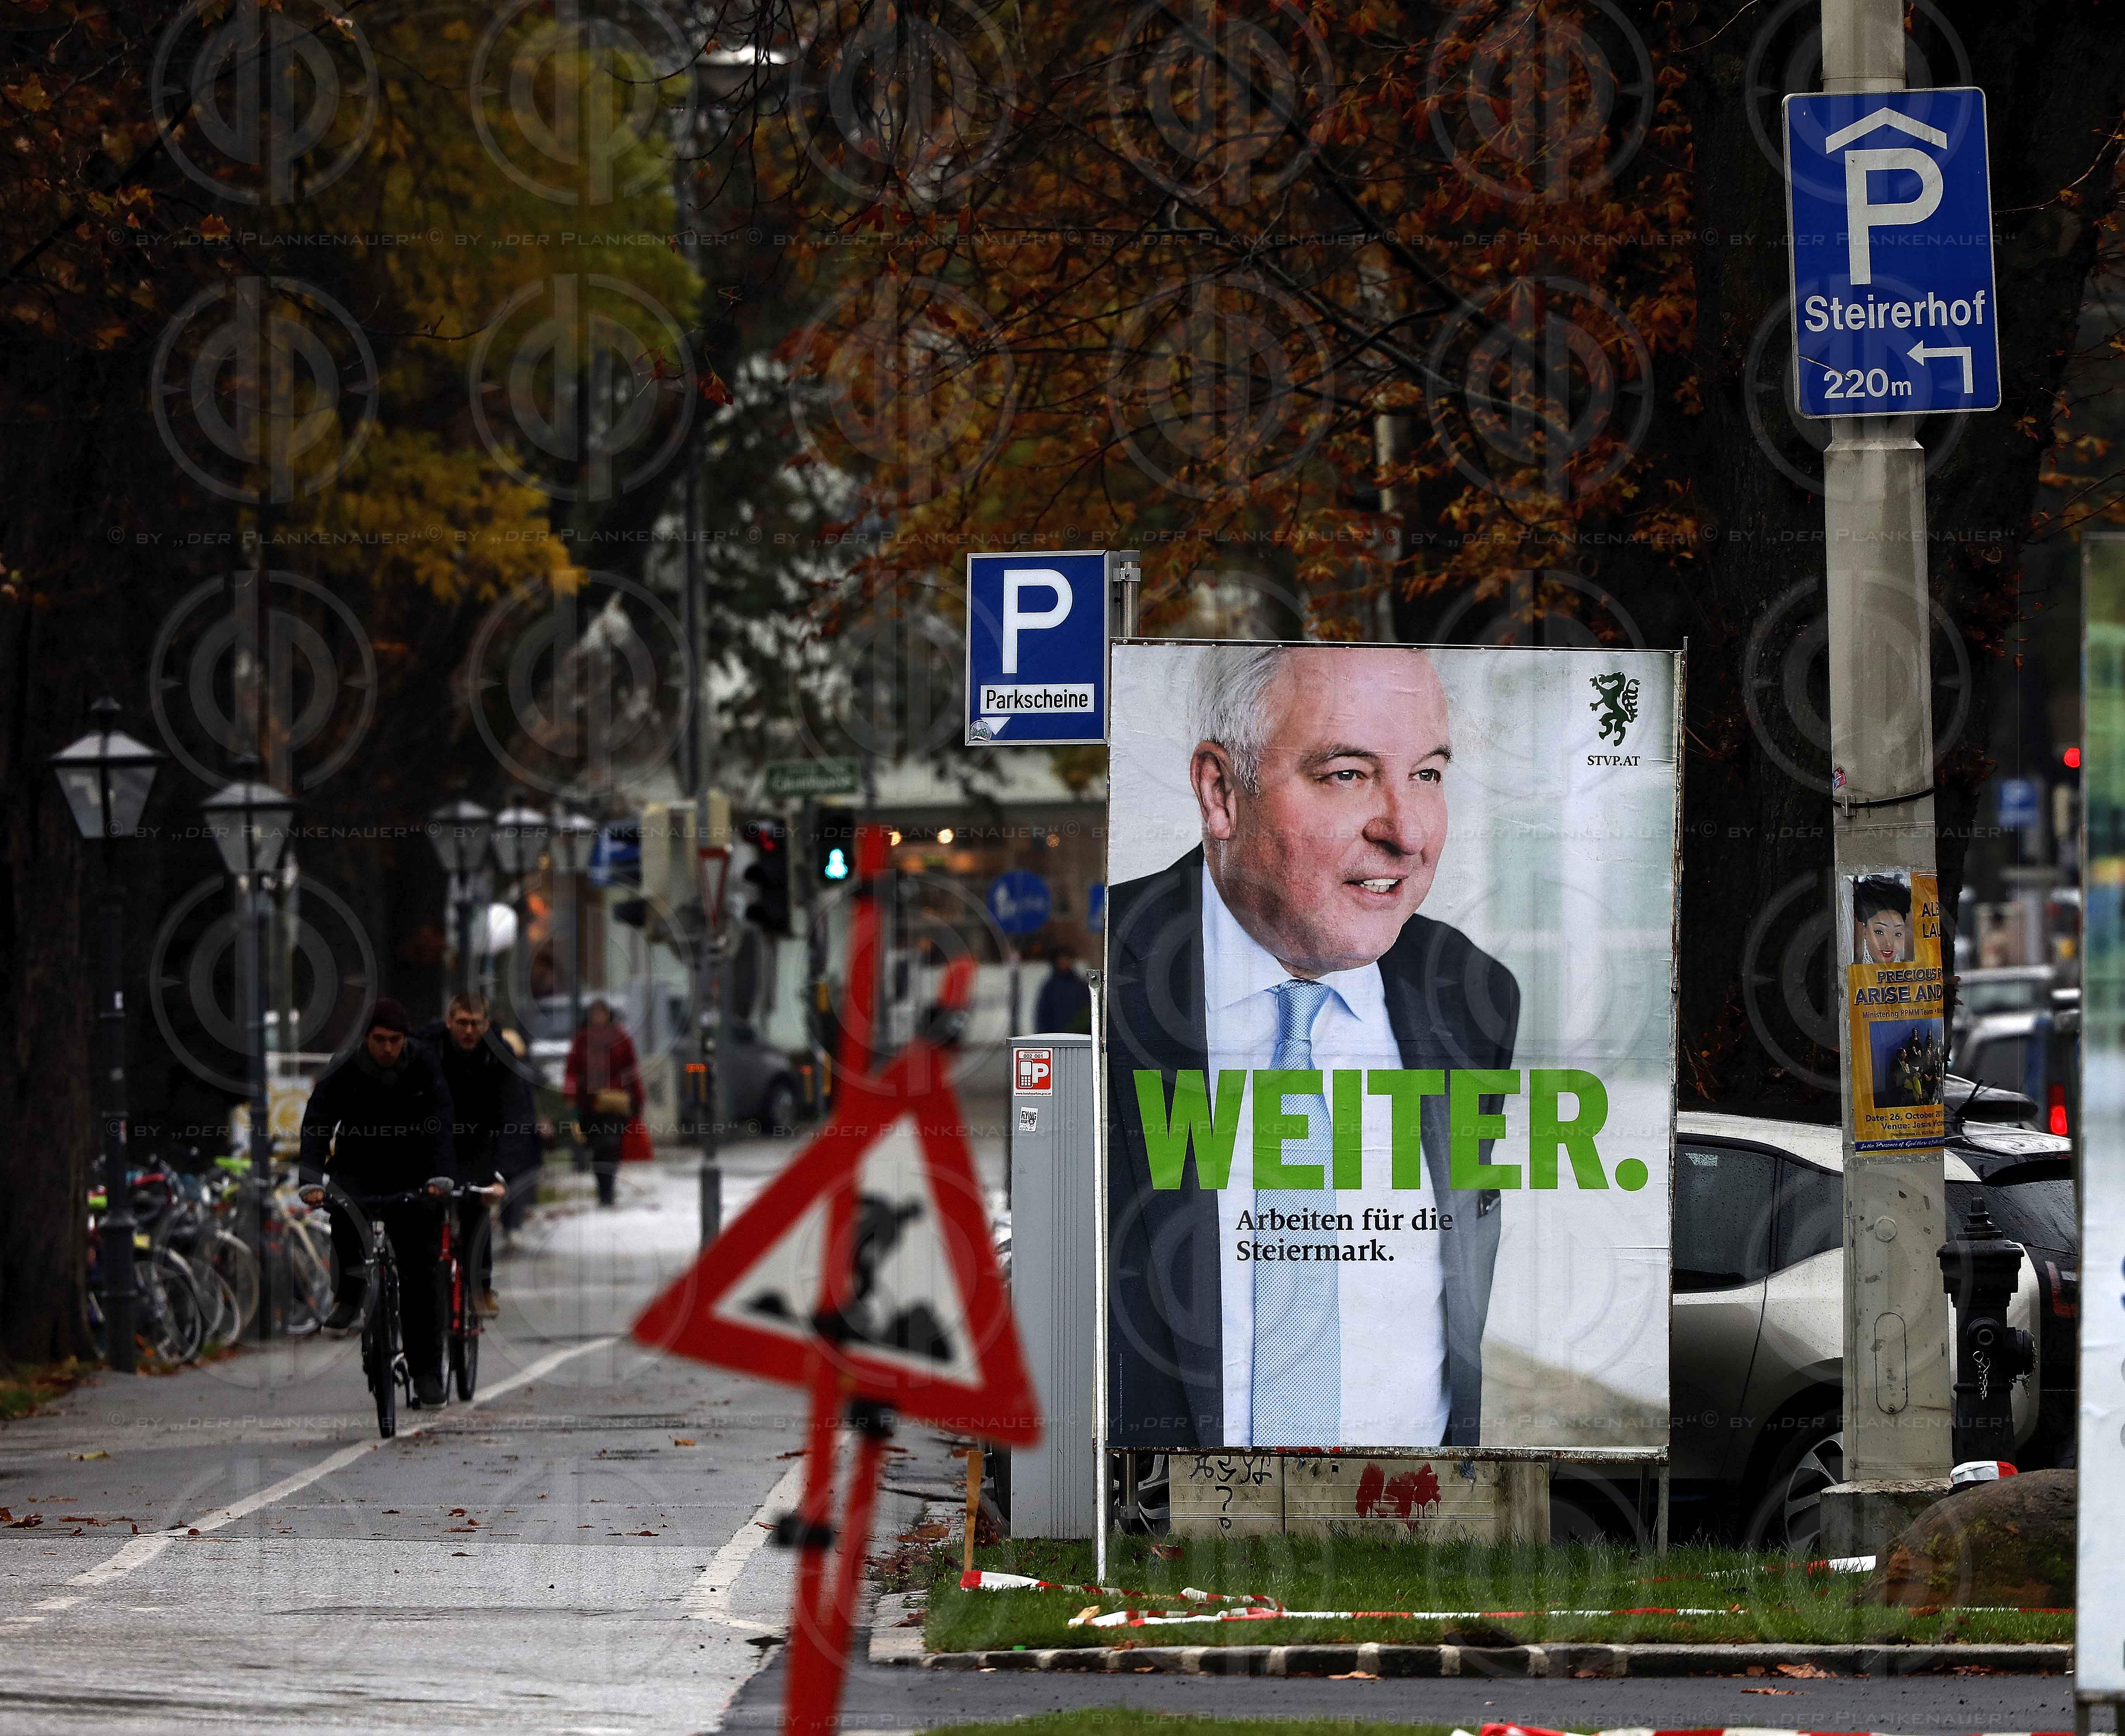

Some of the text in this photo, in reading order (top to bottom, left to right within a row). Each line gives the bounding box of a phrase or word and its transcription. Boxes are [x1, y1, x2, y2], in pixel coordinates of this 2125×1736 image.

[1845, 148, 1943, 284] P
[1805, 290, 1985, 332] Steirerhof
[1002, 569, 1073, 673] P
[986, 689, 1088, 709] Parkscheine
[1588, 756, 1640, 766] STVP.AT
[1877, 968, 1936, 983] PRECIOUS
[1854, 983, 1942, 1006] ARISE AND
[1862, 1010, 1898, 1018] Ministering
[1032, 1063, 1049, 1083] P
[1890, 1113, 1902, 1121] 26,
[1905, 1111, 1934, 1119] October
[1133, 1070, 1648, 1189] WEITER.
[1236, 1208, 1453, 1231] Arbeiten für die
[1236, 1240, 1394, 1262] Steiermark.
